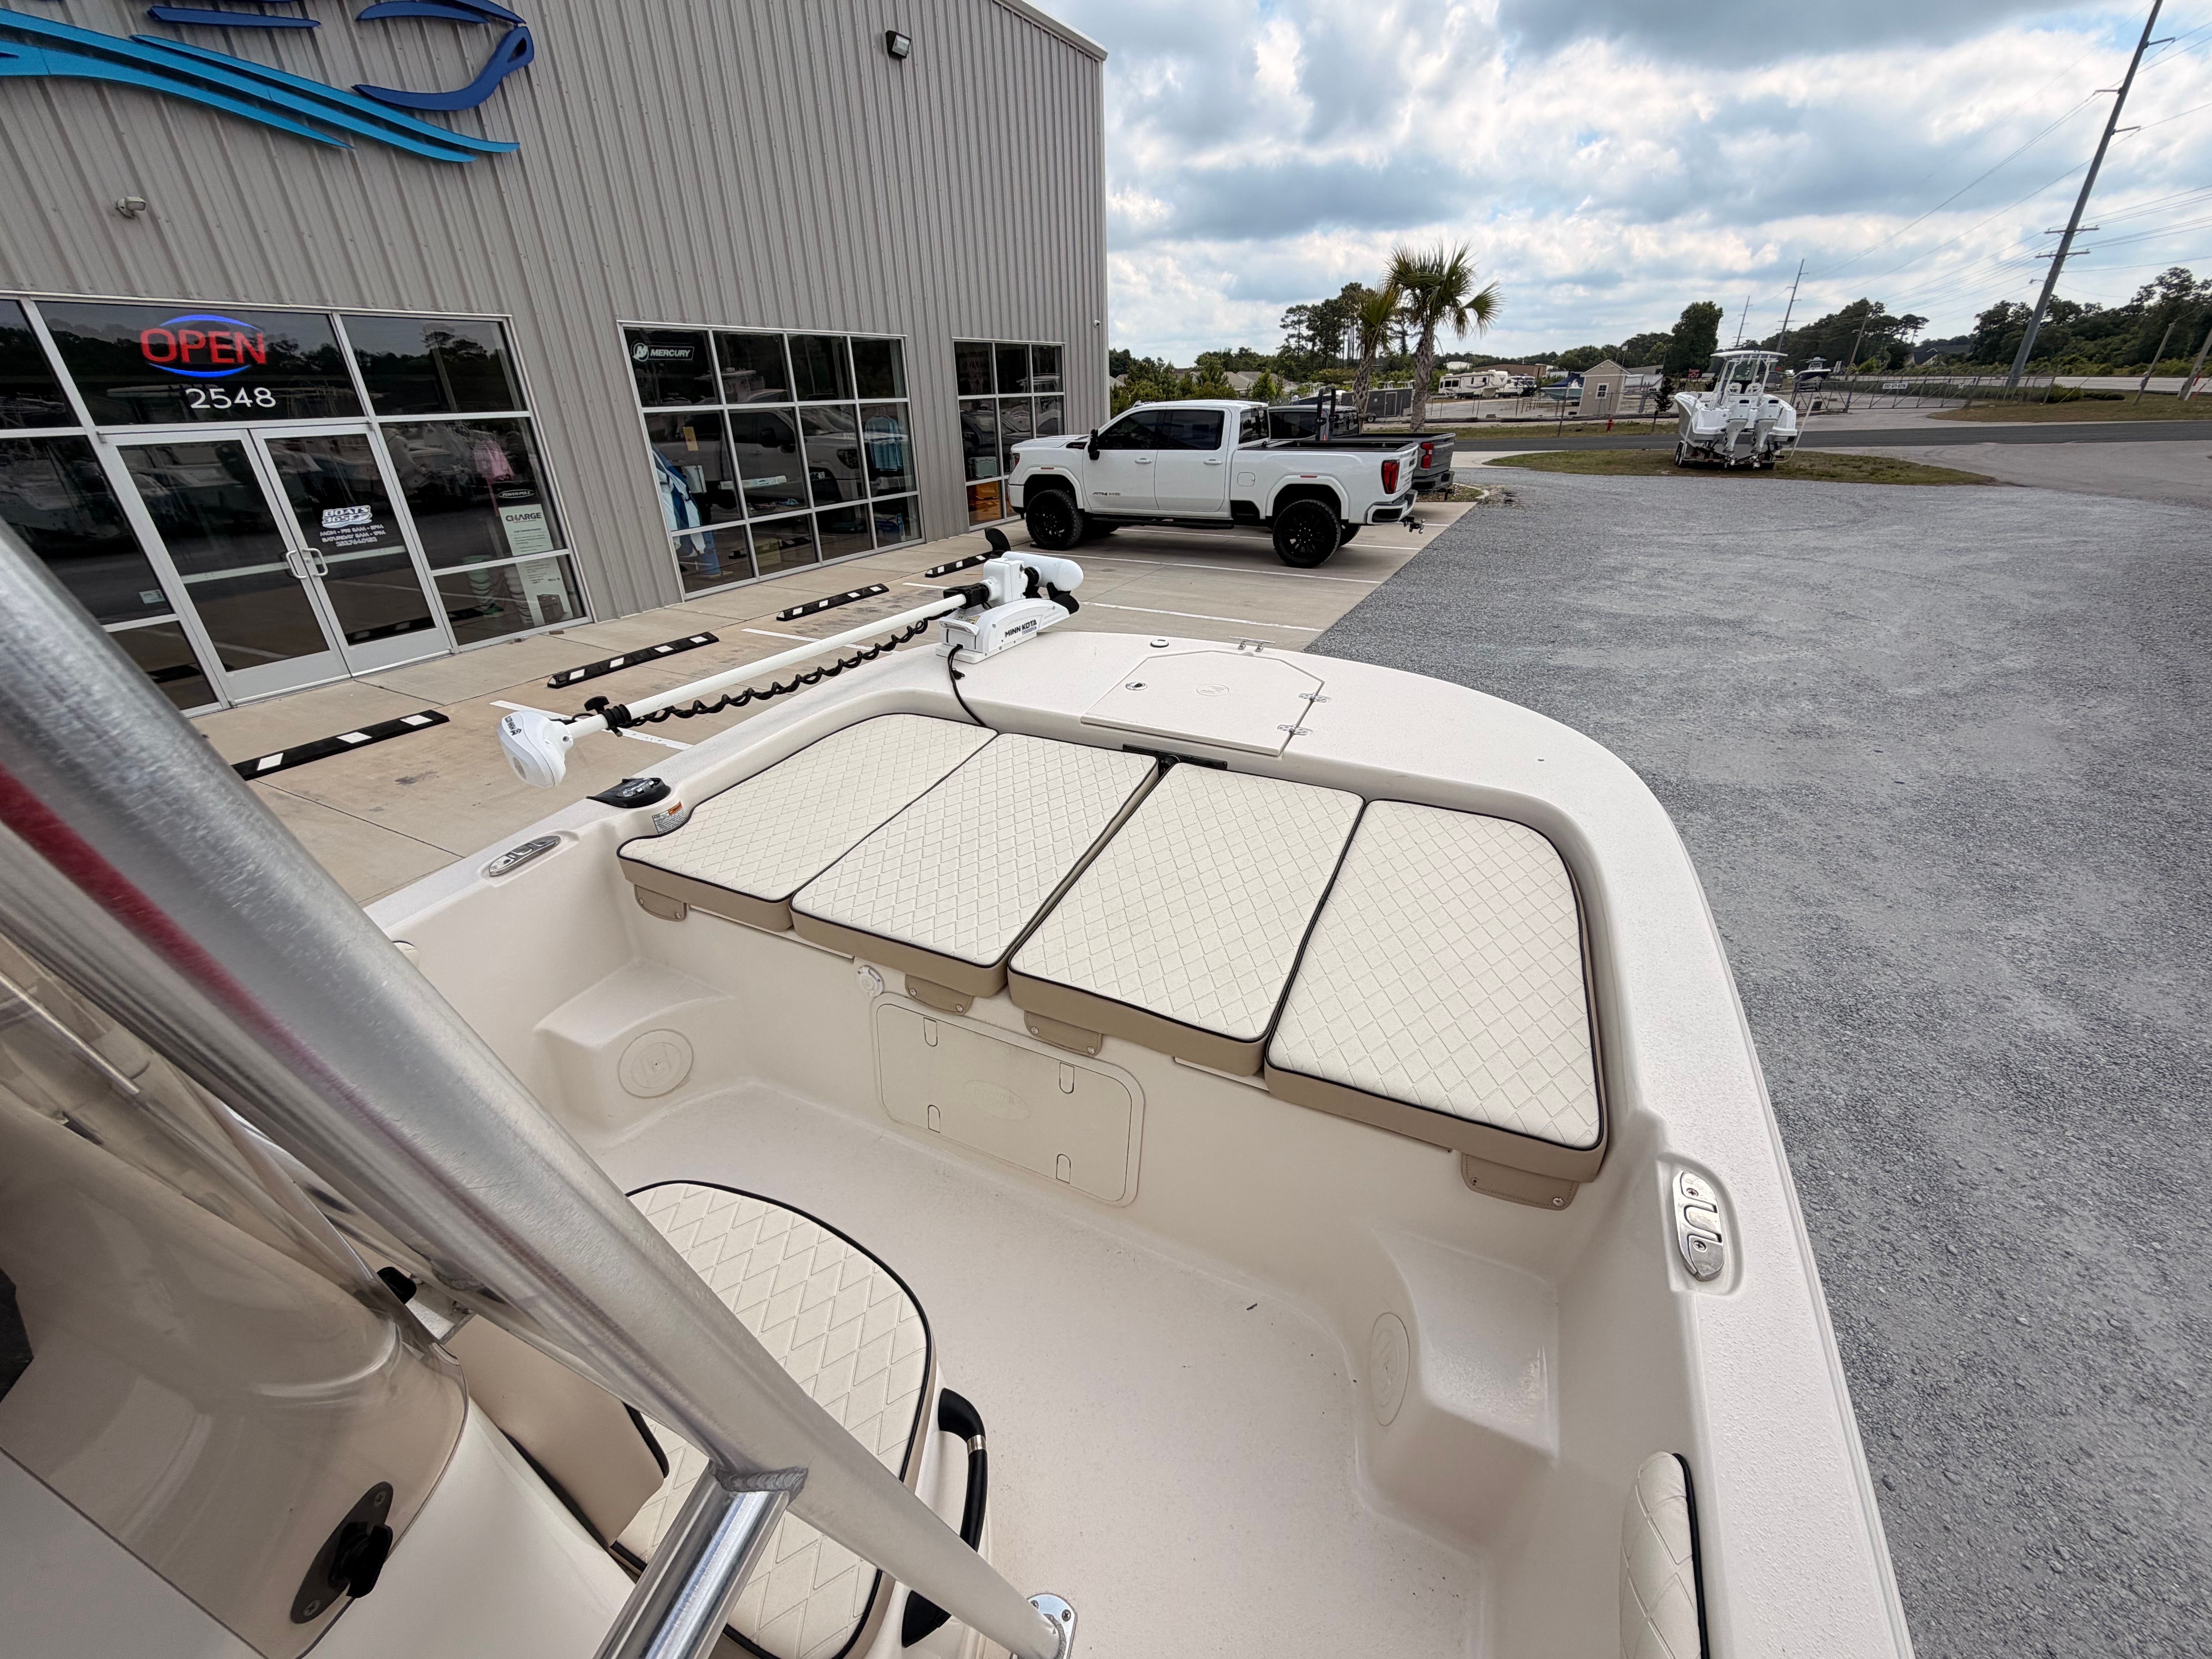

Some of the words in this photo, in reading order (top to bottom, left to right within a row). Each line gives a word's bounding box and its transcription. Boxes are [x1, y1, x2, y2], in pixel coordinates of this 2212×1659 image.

[140, 328, 266, 364] OPEN
[650, 349, 690, 357] MERCURY
[185, 387, 276, 409] 2548
[325, 507, 369, 517] BOATS
[505, 512, 542, 522] CHARGE
[325, 515, 349, 523] 365
[1005, 625, 1021, 637] MINN
[1022, 619, 1037, 630] KOTA
